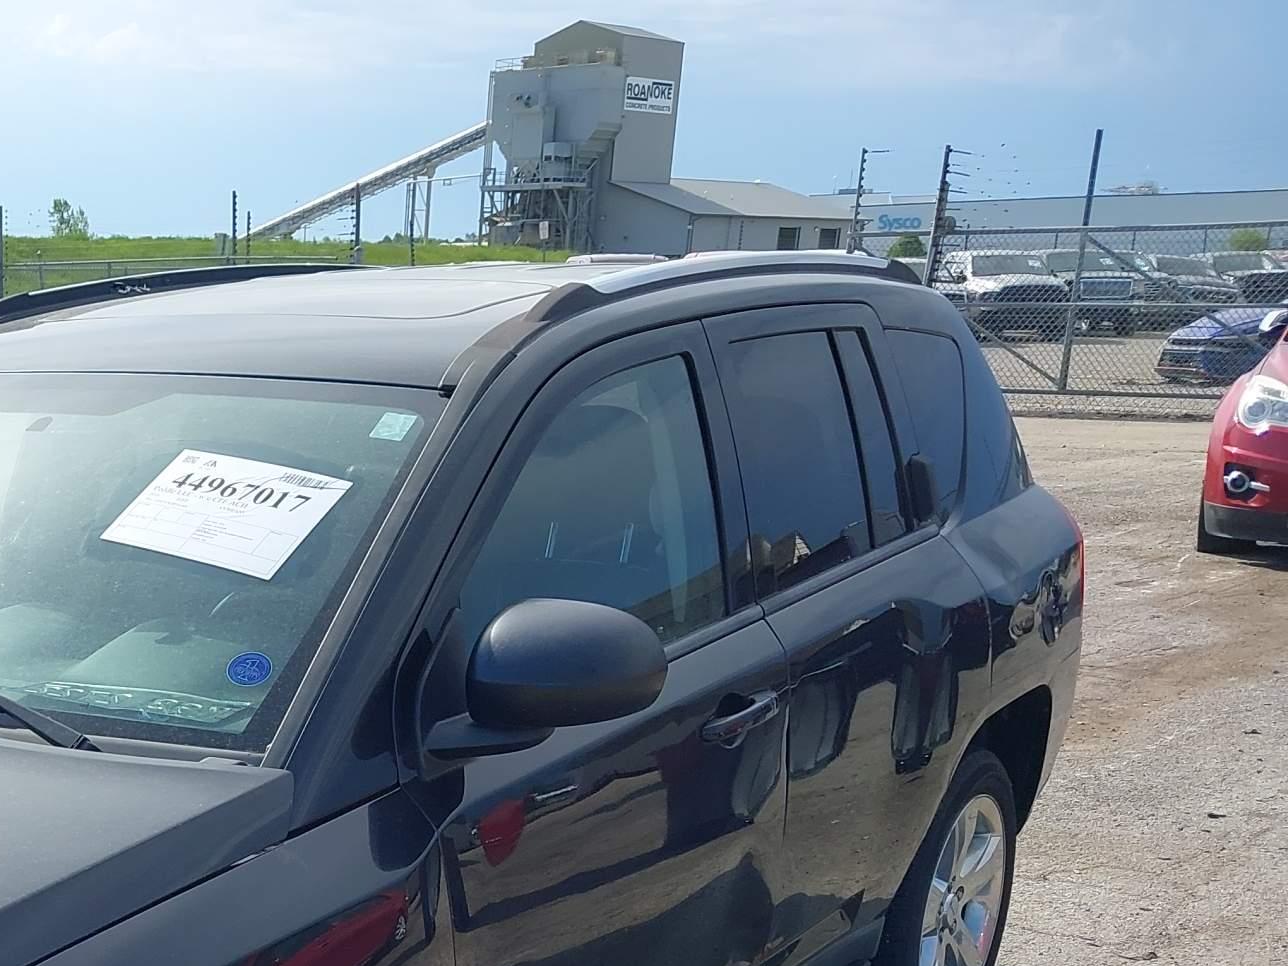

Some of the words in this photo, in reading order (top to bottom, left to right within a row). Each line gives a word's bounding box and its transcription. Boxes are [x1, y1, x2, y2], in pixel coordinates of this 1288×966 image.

[626, 82, 673, 100] ROANOKE
[878, 214, 922, 231] Sysco
[172, 473, 312, 512] 44967017
